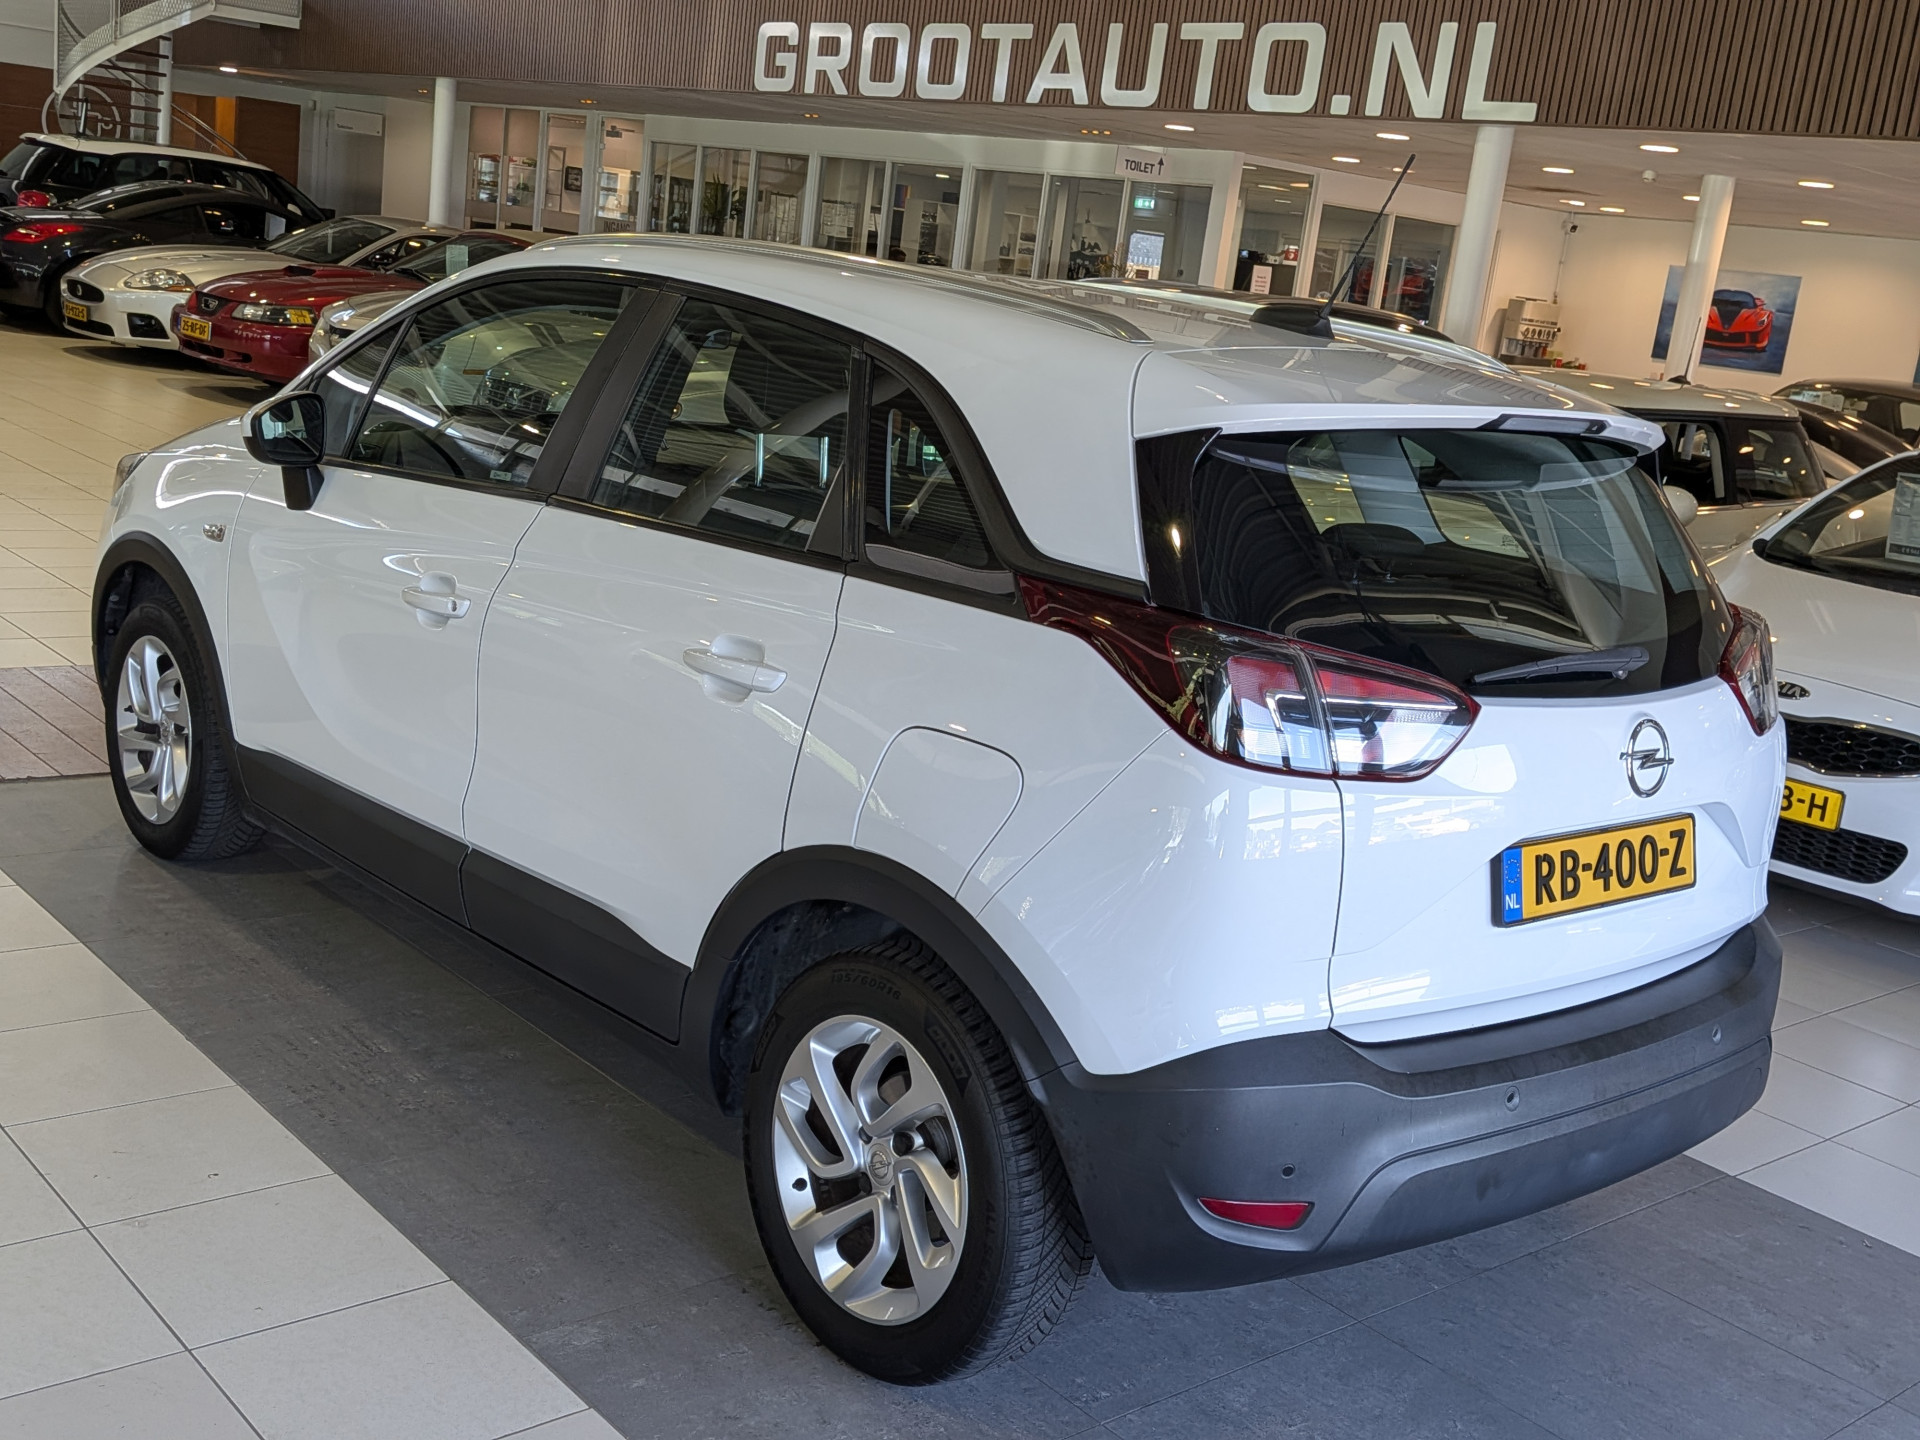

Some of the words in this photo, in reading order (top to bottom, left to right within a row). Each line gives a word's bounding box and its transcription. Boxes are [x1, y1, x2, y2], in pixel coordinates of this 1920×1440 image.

[754, 21, 1538, 122] GROOTAUTO.NL
[1125, 159, 1155, 174] TOILET
[1535, 828, 1687, 906] RB-400-Z
[1505, 894, 1521, 910] NL
